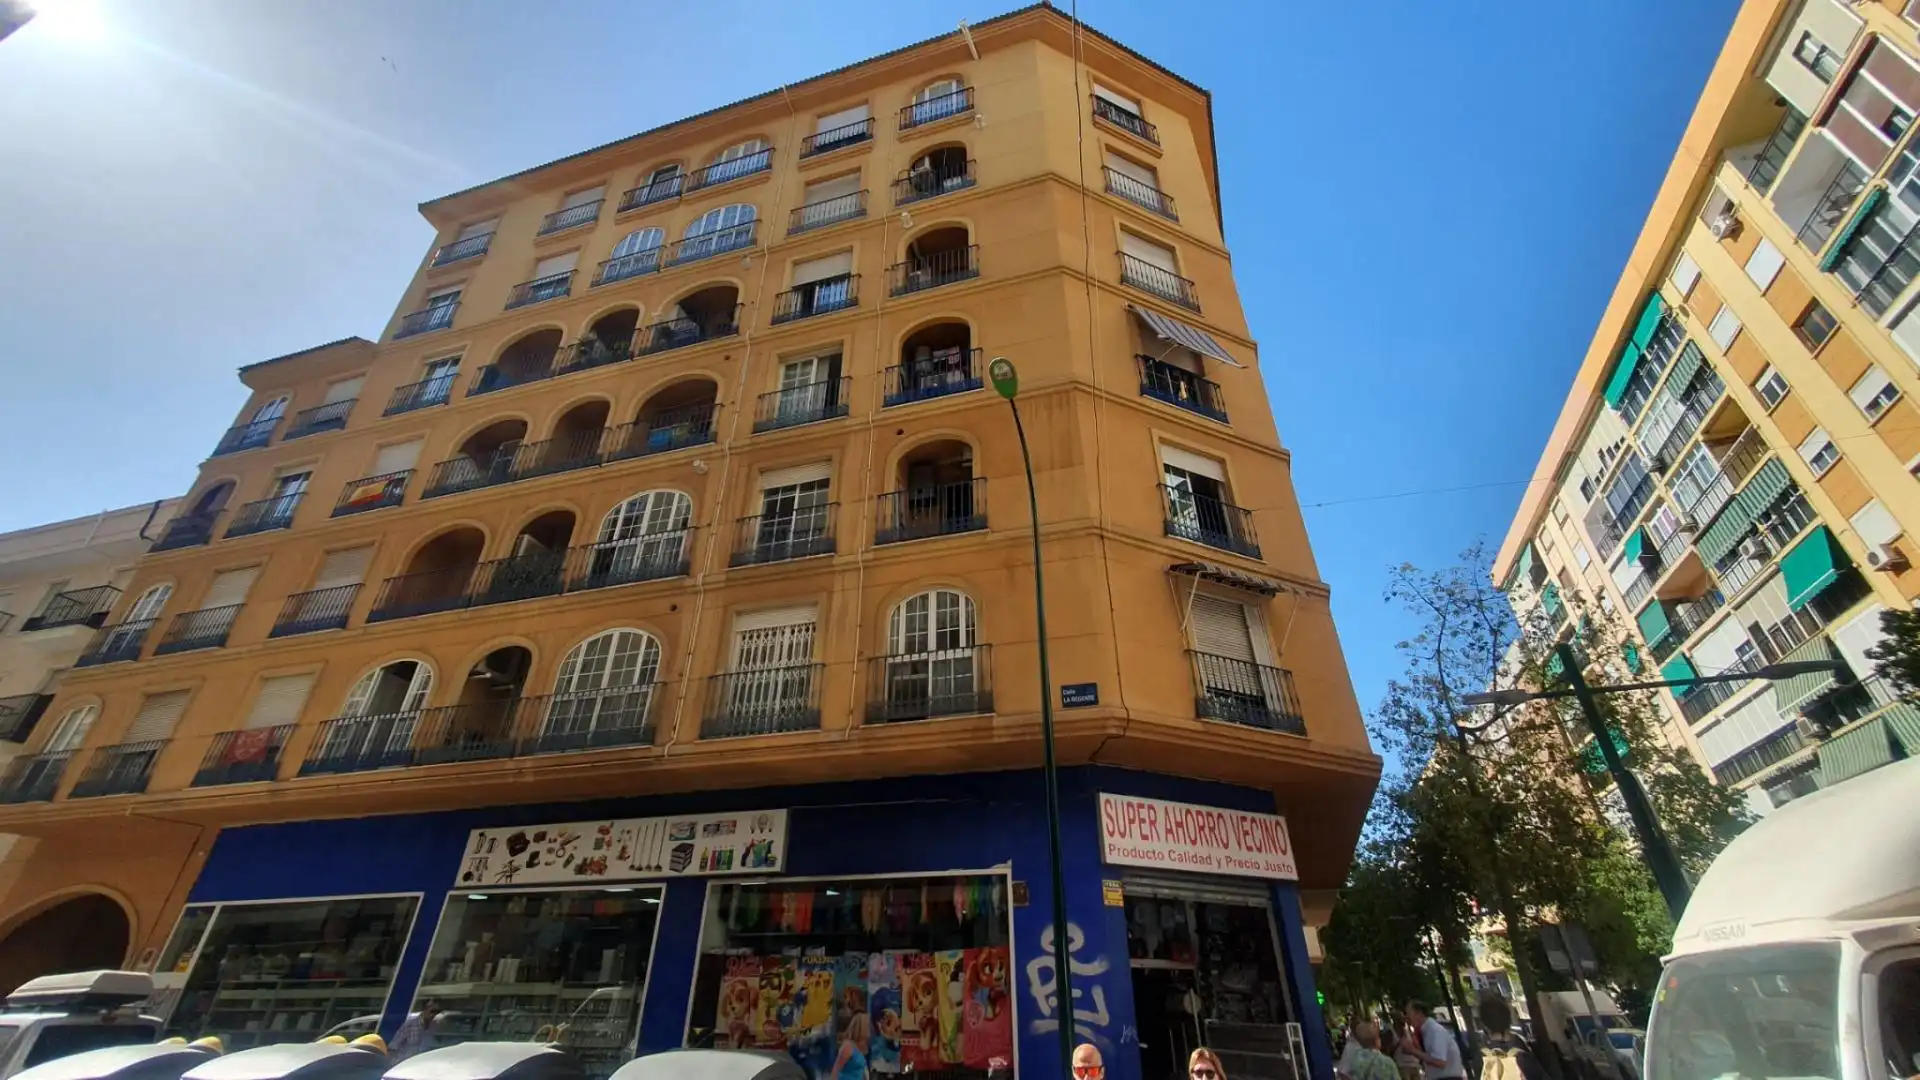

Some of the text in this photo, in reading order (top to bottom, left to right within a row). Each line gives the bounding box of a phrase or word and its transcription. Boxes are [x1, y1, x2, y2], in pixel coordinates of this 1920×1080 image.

[1104, 798, 1288, 856] SUPER AHORRO VECINO
[1108, 843, 1293, 874] Producto Calidad y Precio Justo
[1704, 923, 1746, 942] NISSAN
